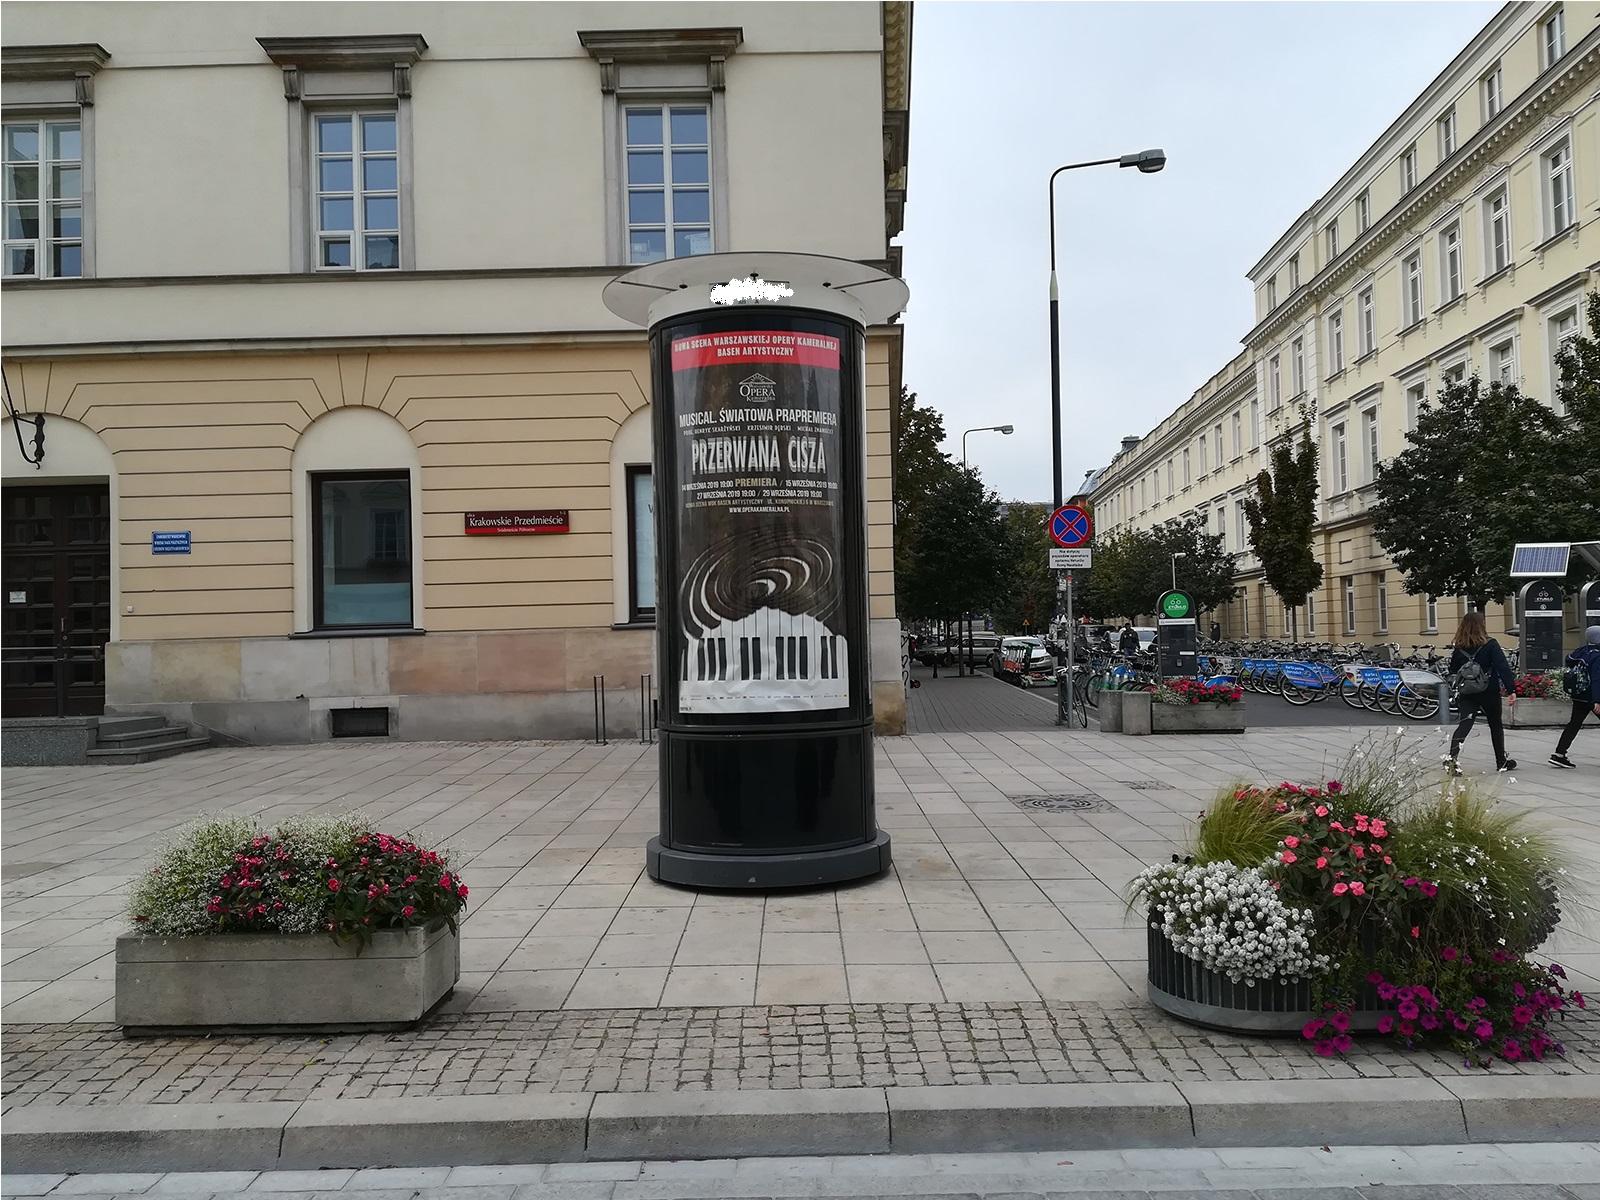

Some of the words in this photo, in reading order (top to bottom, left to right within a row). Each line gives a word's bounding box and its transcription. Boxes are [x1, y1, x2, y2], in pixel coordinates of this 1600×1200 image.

[691, 338, 712, 349] SCENA
[713, 335, 770, 346] WARSZAWSKIEJ
[772, 335, 796, 345] OPERY
[797, 336, 837, 351] KAMERALNEJ
[717, 347, 740, 357] BASEN
[742, 346, 794, 356] ARTYSTYCZNY
[739, 384, 776, 397] OPERA
[679, 411, 717, 428] MUSICAL.
[719, 407, 774, 423] ŚWIATOWA
[775, 408, 837, 426] PRAPREMIERA
[692, 435, 781, 475] PRZERWANA
[787, 435, 827, 474] CISZA
[707, 481, 719, 489] 2019
[735, 477, 778, 487] PREMIERA
[792, 478, 816, 488] WRZEŚNIA
[703, 489, 727, 499] WRZEŚNIA
[727, 489, 741, 498] 2019
[770, 488, 797, 497] WRZEŚNIA
[797, 489, 810, 497] 2019
[469, 516, 511, 526] Krakowskie
[514, 515, 563, 525] Przedmieście
